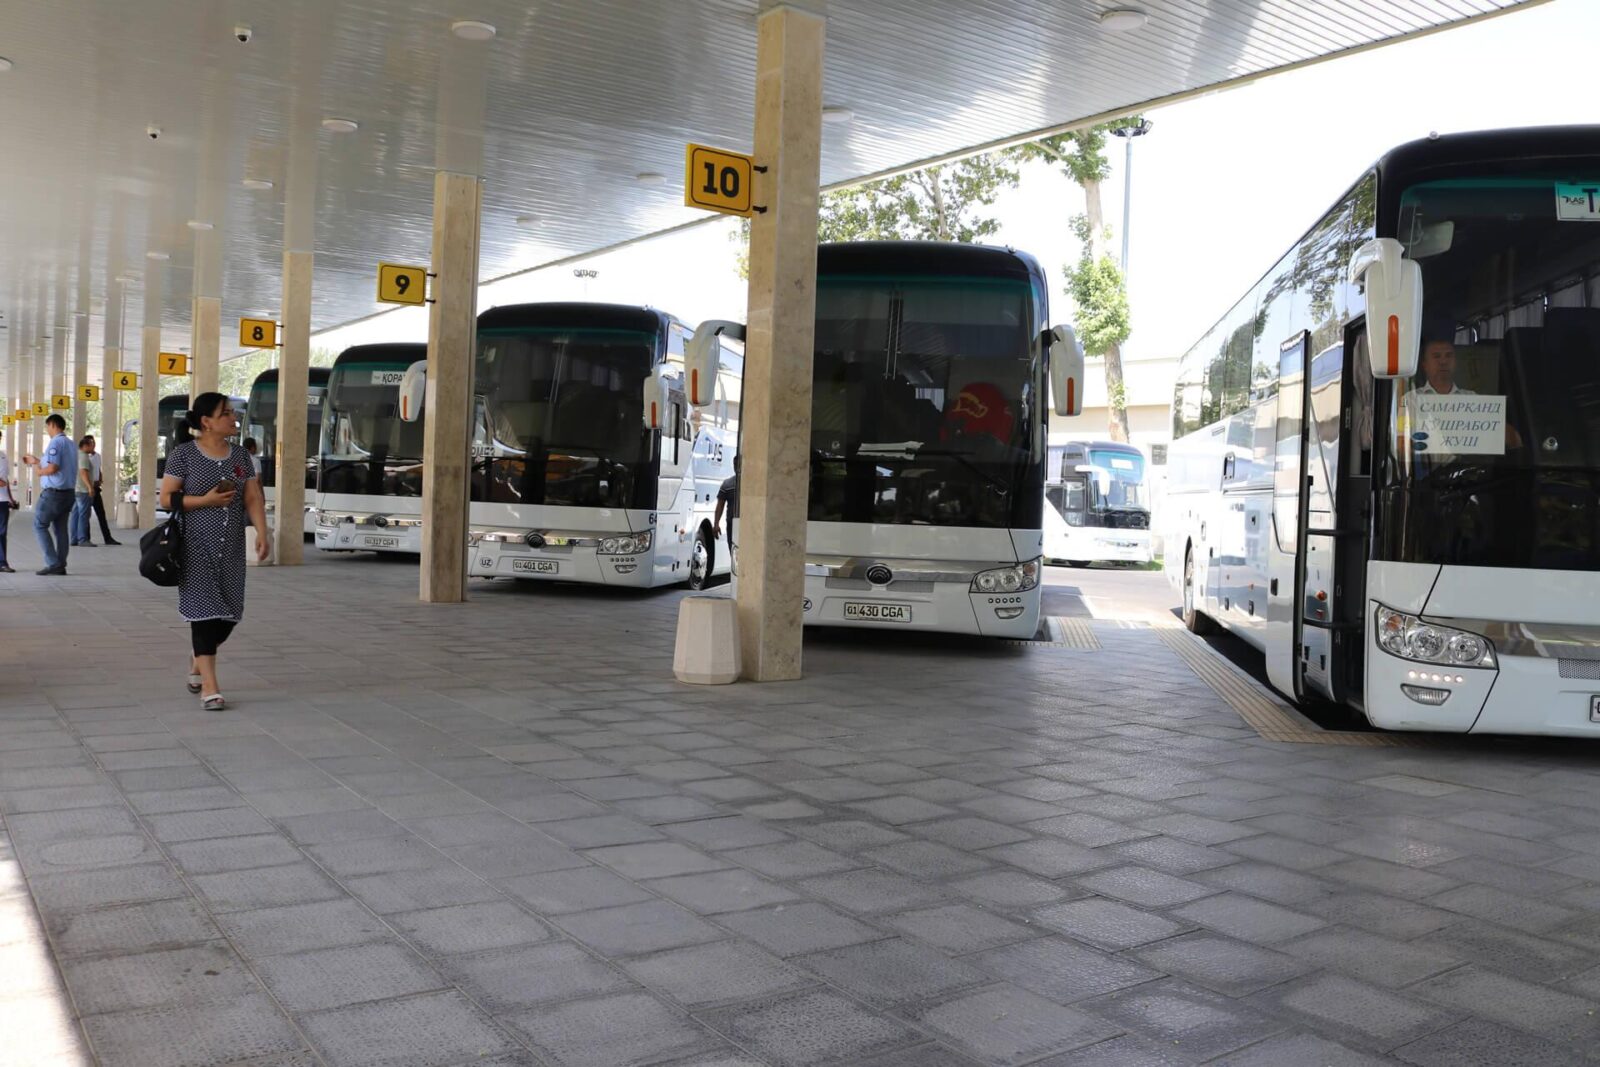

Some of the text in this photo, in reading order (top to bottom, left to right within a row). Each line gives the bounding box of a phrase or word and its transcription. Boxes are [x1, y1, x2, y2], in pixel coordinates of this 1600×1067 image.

[702, 161, 740, 198] 10
[394, 274, 411, 295] 9
[252, 326, 264, 341] 8
[168, 358, 177, 370] 7
[120, 376, 129, 386] 6
[85, 389, 92, 398] 5
[57, 398, 64, 406] 4
[1440, 436, 1479, 447] ЖУШ
[523, 562, 536, 570] 401
[538, 563, 553, 571] CGA
[803, 600, 809, 608] Z
[847, 606, 904, 618] 01 430 CGA
